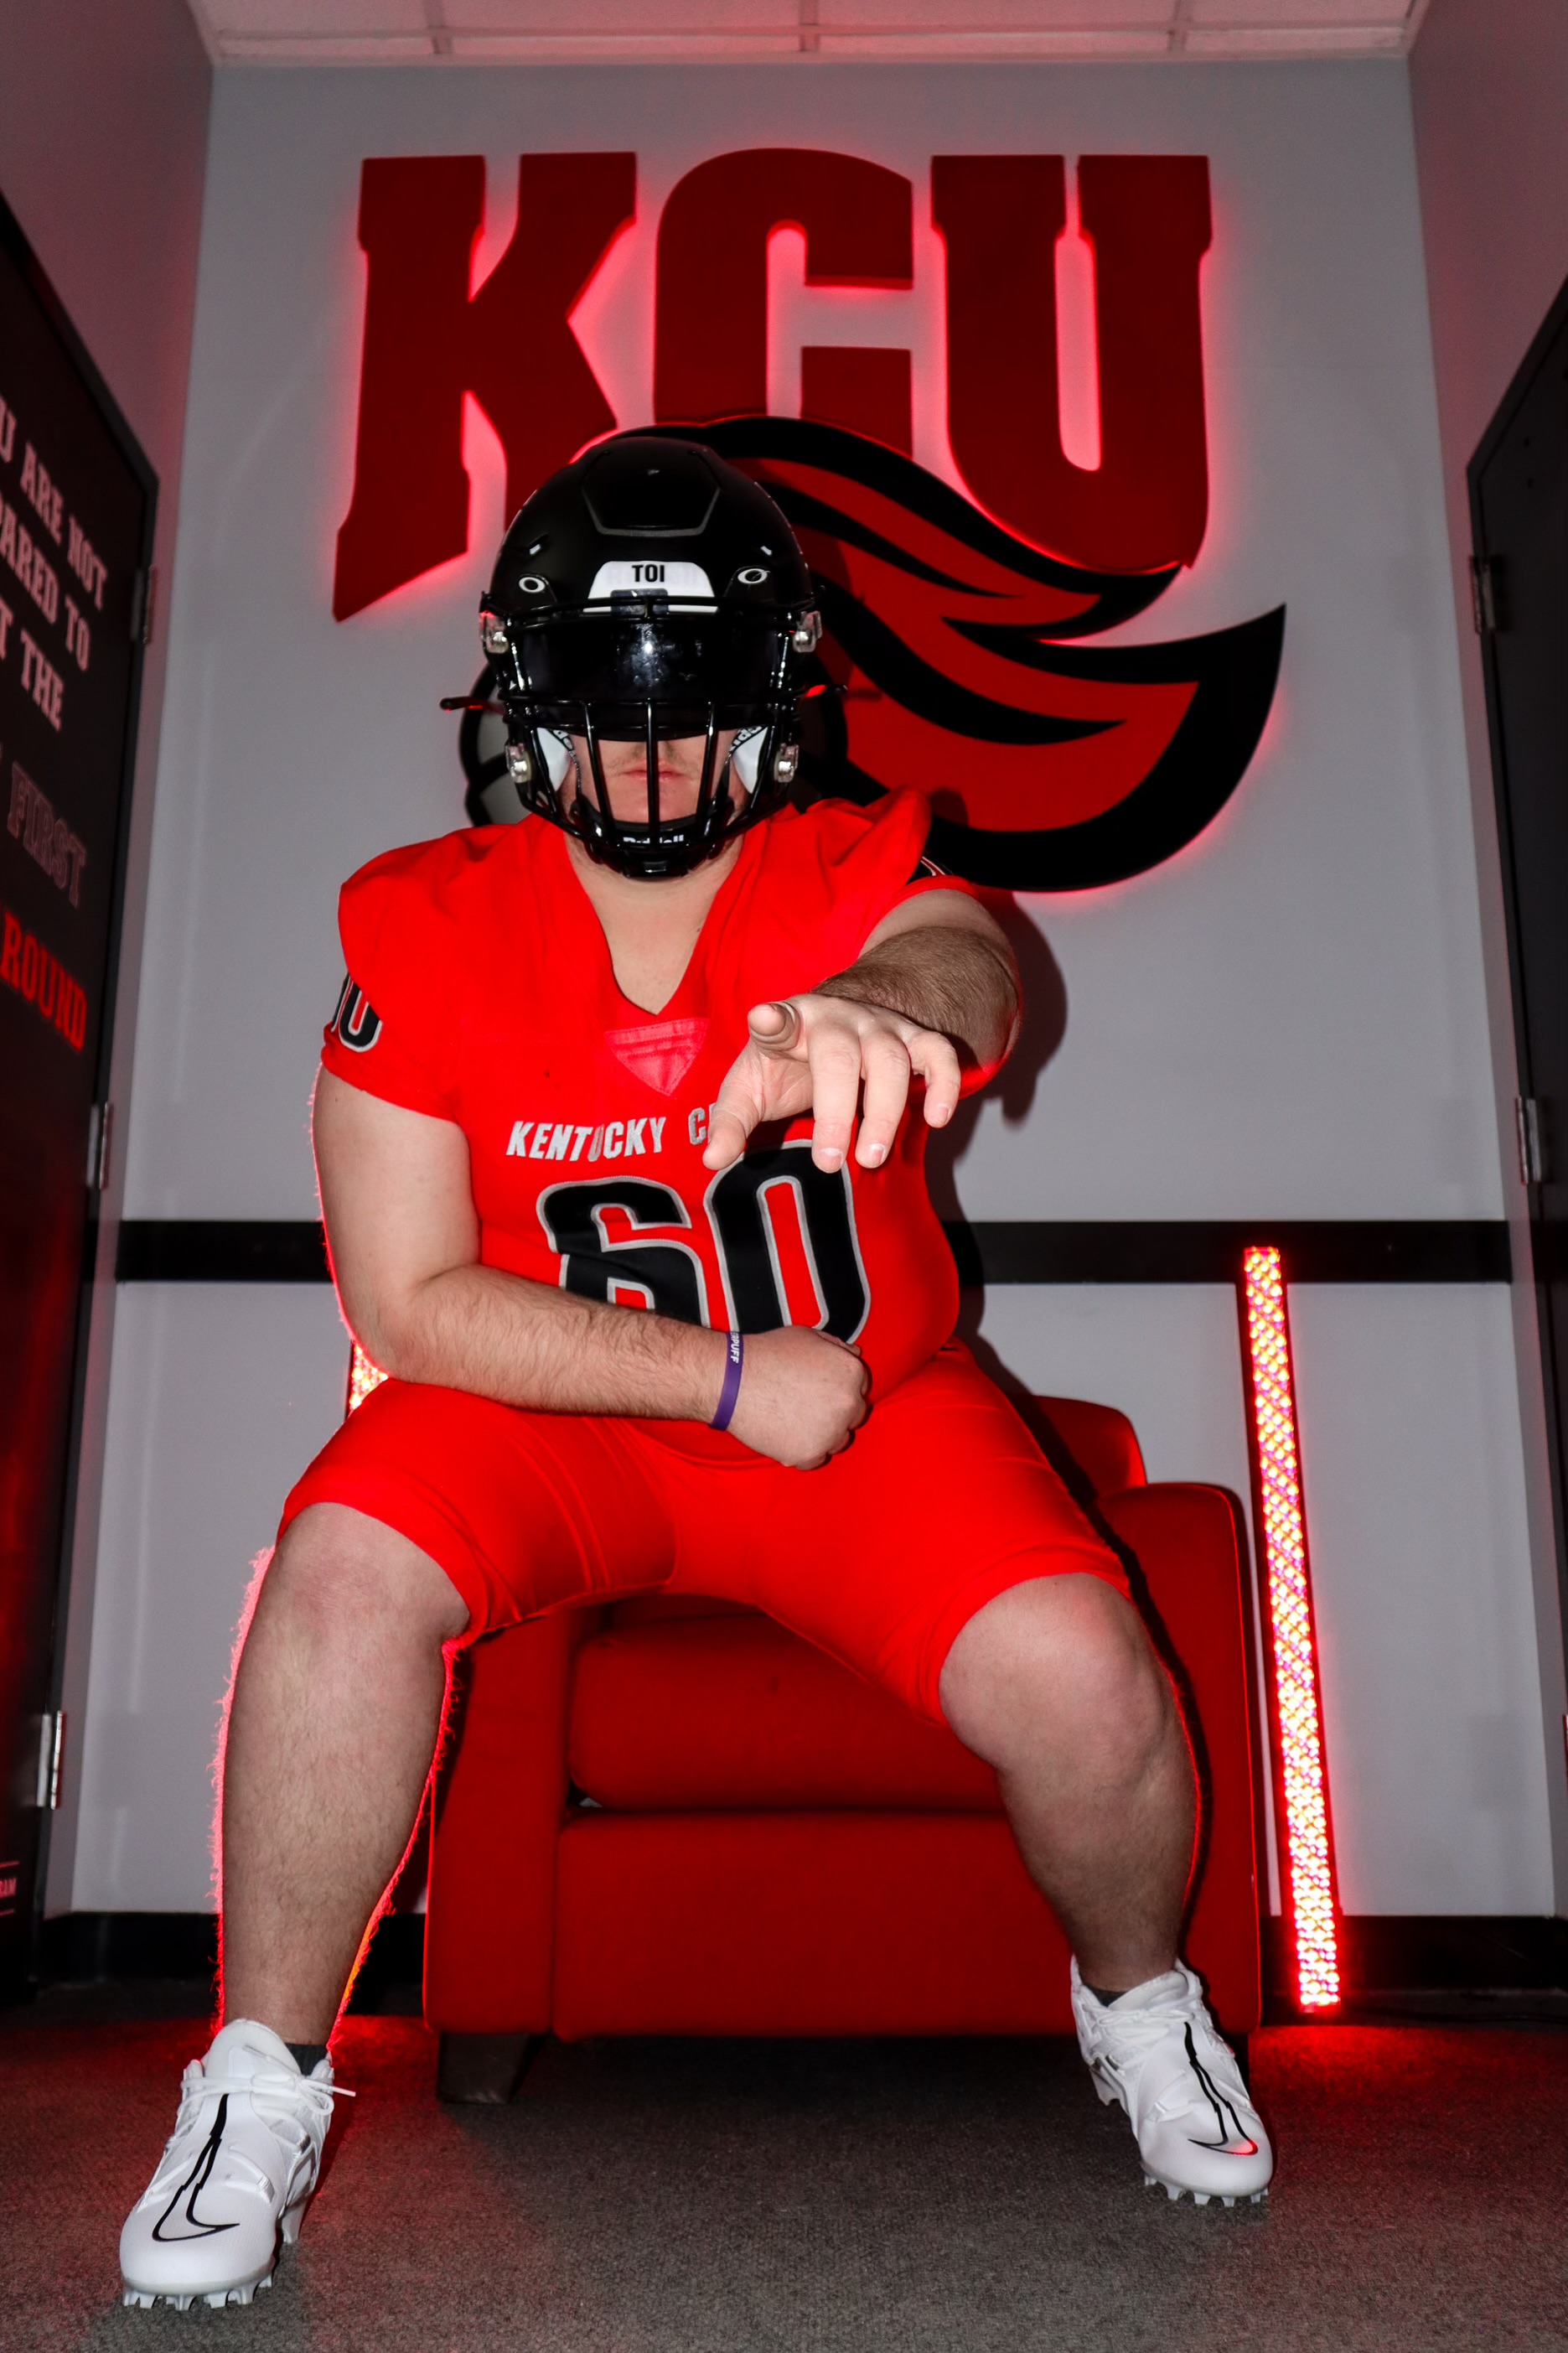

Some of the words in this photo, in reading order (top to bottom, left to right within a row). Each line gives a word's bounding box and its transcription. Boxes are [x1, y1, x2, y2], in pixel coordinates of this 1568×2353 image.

[333, 148, 1213, 624] KCU
[0, 486, 59, 625] ARED
[65, 594, 90, 671] TO
[20, 441, 64, 547] ARE
[67, 514, 107, 611] NOT
[632, 564, 665, 583] TOI
[20, 629, 64, 732] THE
[7, 760, 87, 910] FIRST
[0, 910, 88, 1052] ROUND
[505, 1117, 667, 1162] KENTUCKY
[536, 1138, 872, 1345] 60
